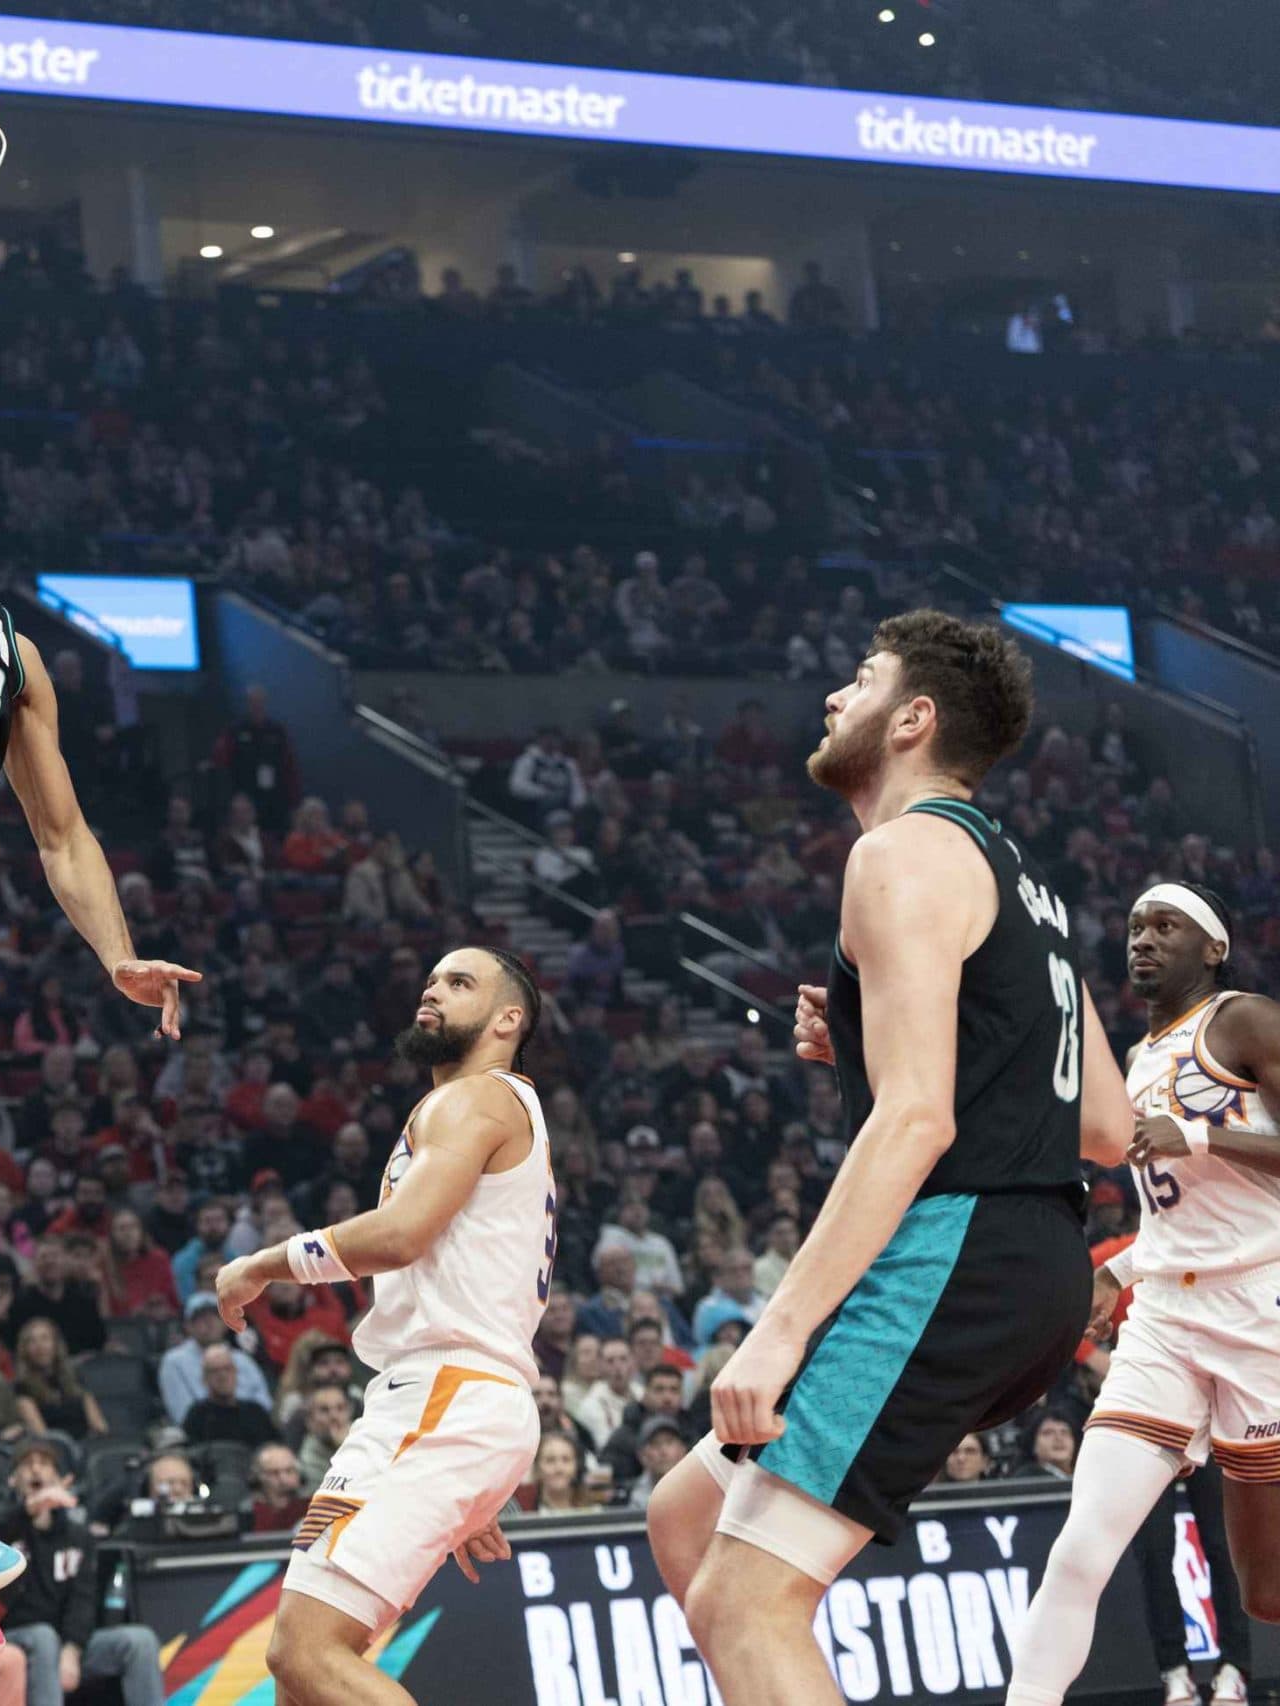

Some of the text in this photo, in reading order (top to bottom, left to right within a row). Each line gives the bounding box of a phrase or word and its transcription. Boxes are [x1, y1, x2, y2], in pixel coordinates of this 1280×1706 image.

[357, 62, 627, 131] ticketmaster
[857, 105, 1097, 169] ticketmaster
[916, 1515, 1019, 1564] BY
[524, 1593, 726, 1706] BLAC
